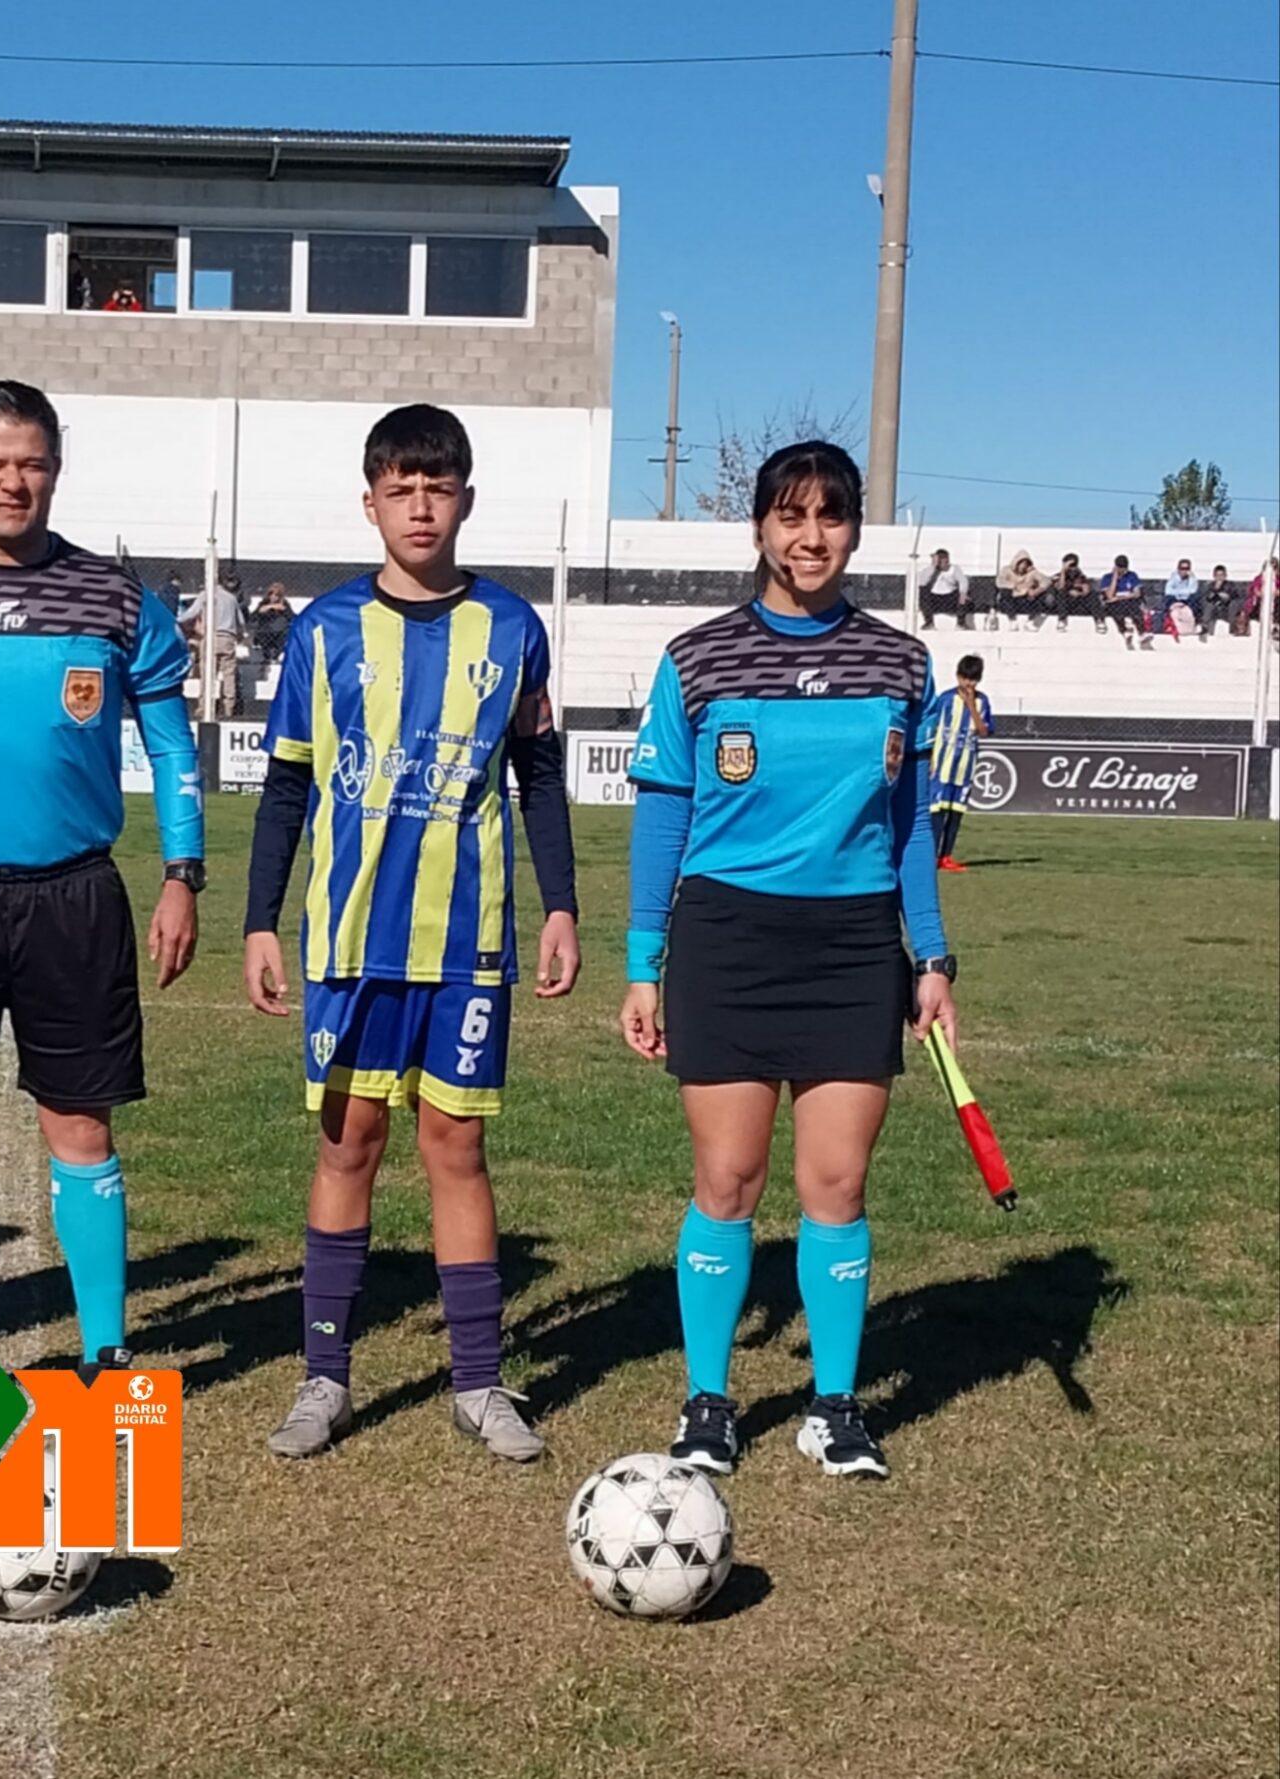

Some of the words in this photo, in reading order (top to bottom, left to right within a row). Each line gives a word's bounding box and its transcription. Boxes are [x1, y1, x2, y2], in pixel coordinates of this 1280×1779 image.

[1041, 756, 1091, 789] El
[1055, 797, 1177, 811] VETERINARIA
[460, 997, 493, 1044] 6
